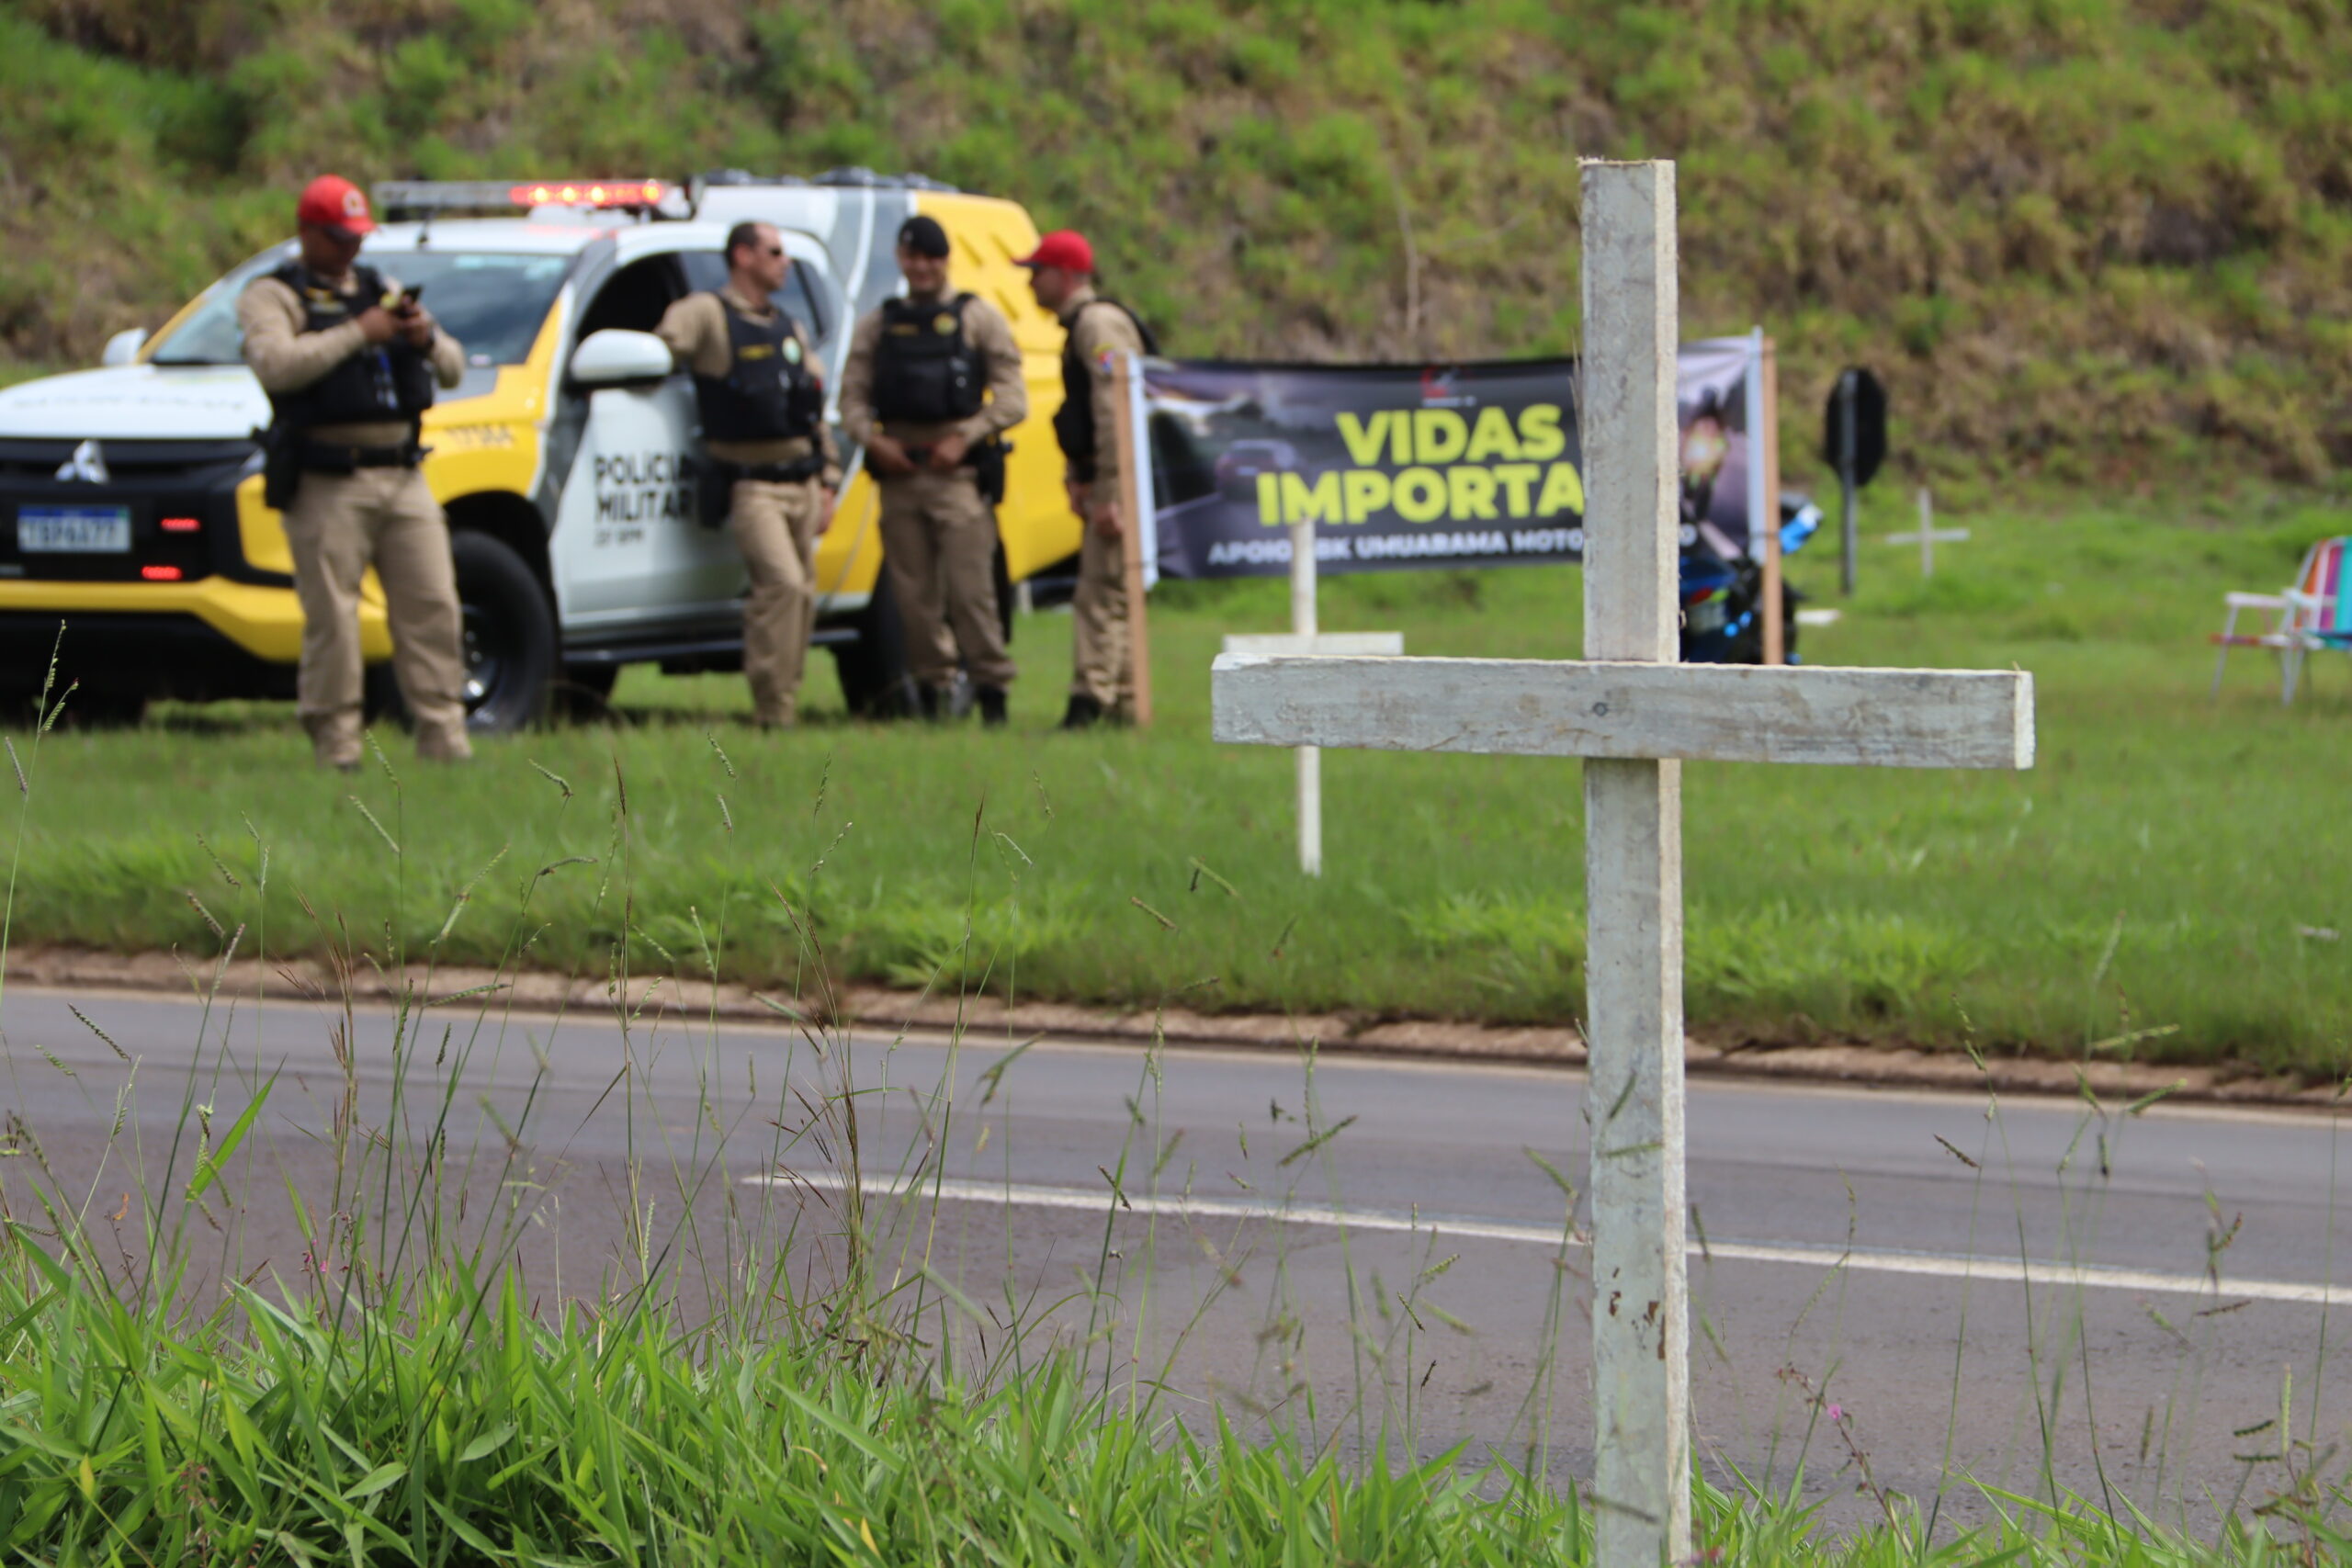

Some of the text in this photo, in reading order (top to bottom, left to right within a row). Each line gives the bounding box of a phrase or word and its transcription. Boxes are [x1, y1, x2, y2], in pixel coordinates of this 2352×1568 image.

[1336, 404, 1566, 466] VIDAS
[1256, 462, 1584, 526] IMPORTA
[1355, 530, 1509, 559] UMUARAMA
